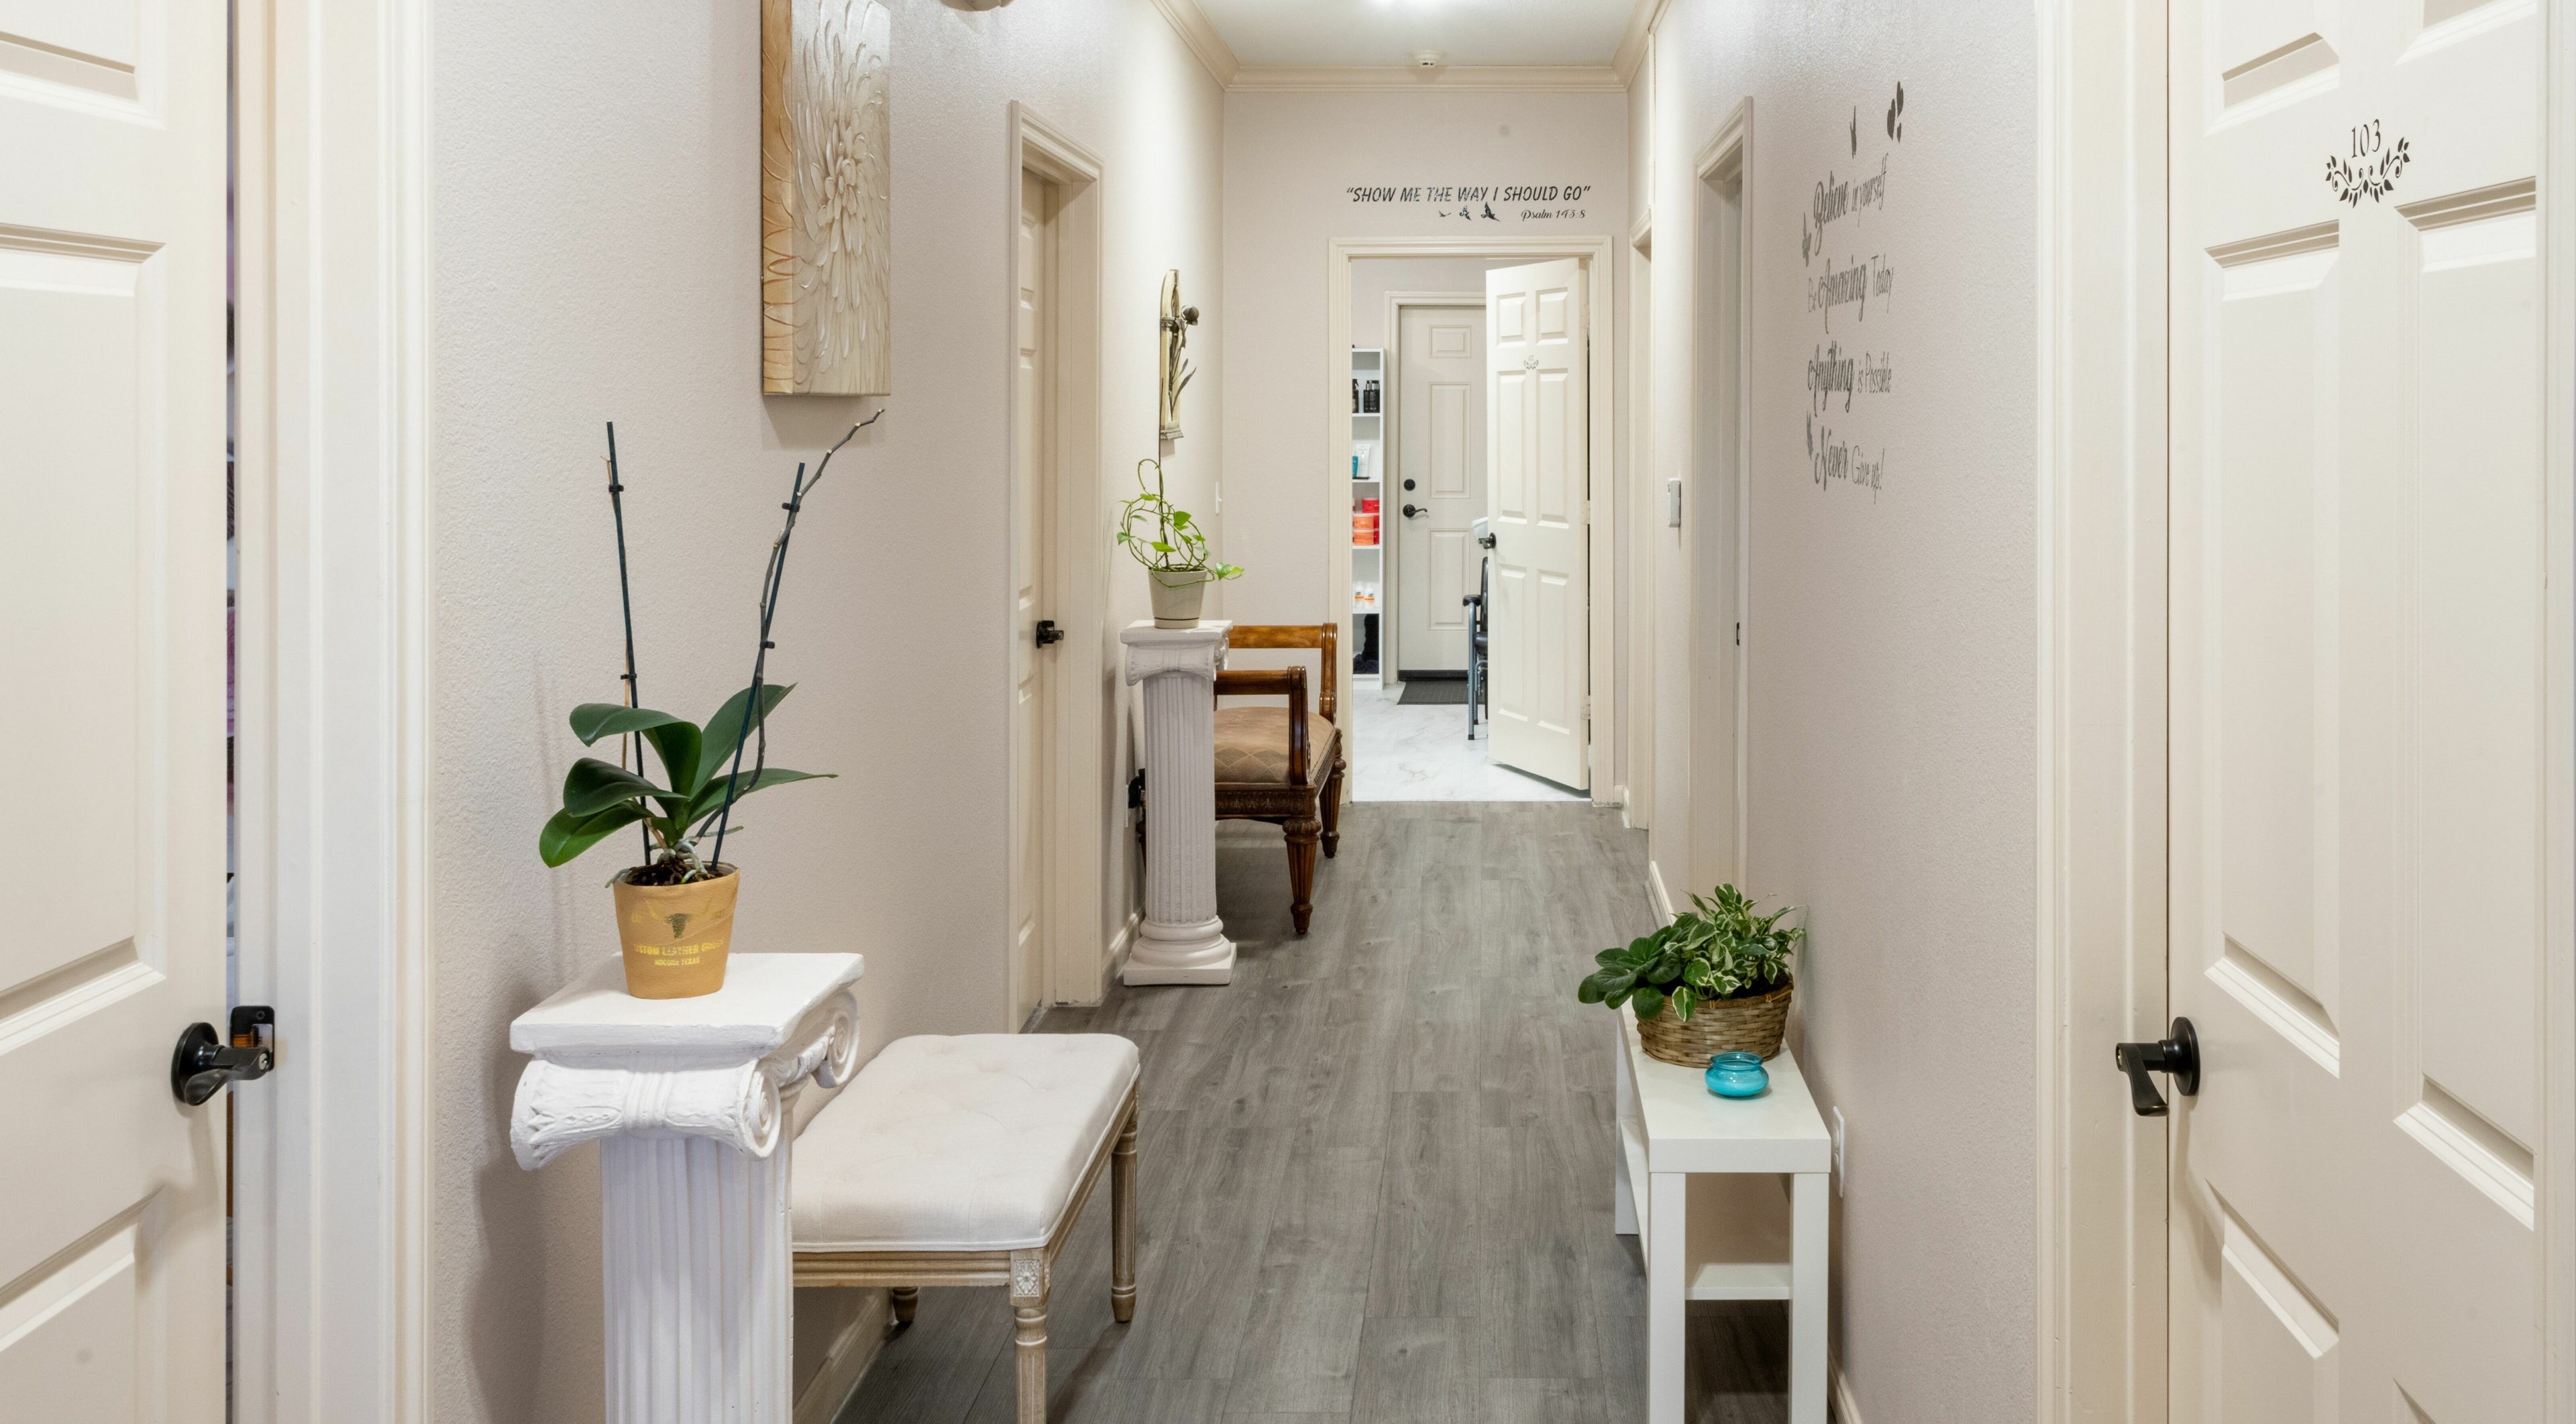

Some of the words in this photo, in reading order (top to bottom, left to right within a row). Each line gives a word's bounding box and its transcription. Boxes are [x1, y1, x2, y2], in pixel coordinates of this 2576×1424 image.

[2351, 119, 2381, 158] 103
[1399, 187, 1421, 202] ME
[1427, 186, 1452, 202] THE
[1458, 186, 1489, 202] WAY
[1493, 186, 1498, 201] I
[1503, 186, 1558, 201] SHOULD
[1521, 209, 1552, 222] Psalm
[1814, 170, 1849, 257] Believe
[1851, 178, 1859, 212] in
[1858, 152, 1888, 228] yourself
[1808, 277, 1817, 313] Be
[1818, 254, 1868, 334] Amazing
[1871, 252, 1894, 313] Today
[1807, 340, 1855, 418] Anything
[1858, 360, 1864, 393] is
[1865, 350, 1892, 393] Possible
[1814, 426, 1849, 492] Never
[1851, 445, 1870, 486] Give
[1871, 448, 1885, 505] up!
[681, 956, 700, 966] TEXAS
